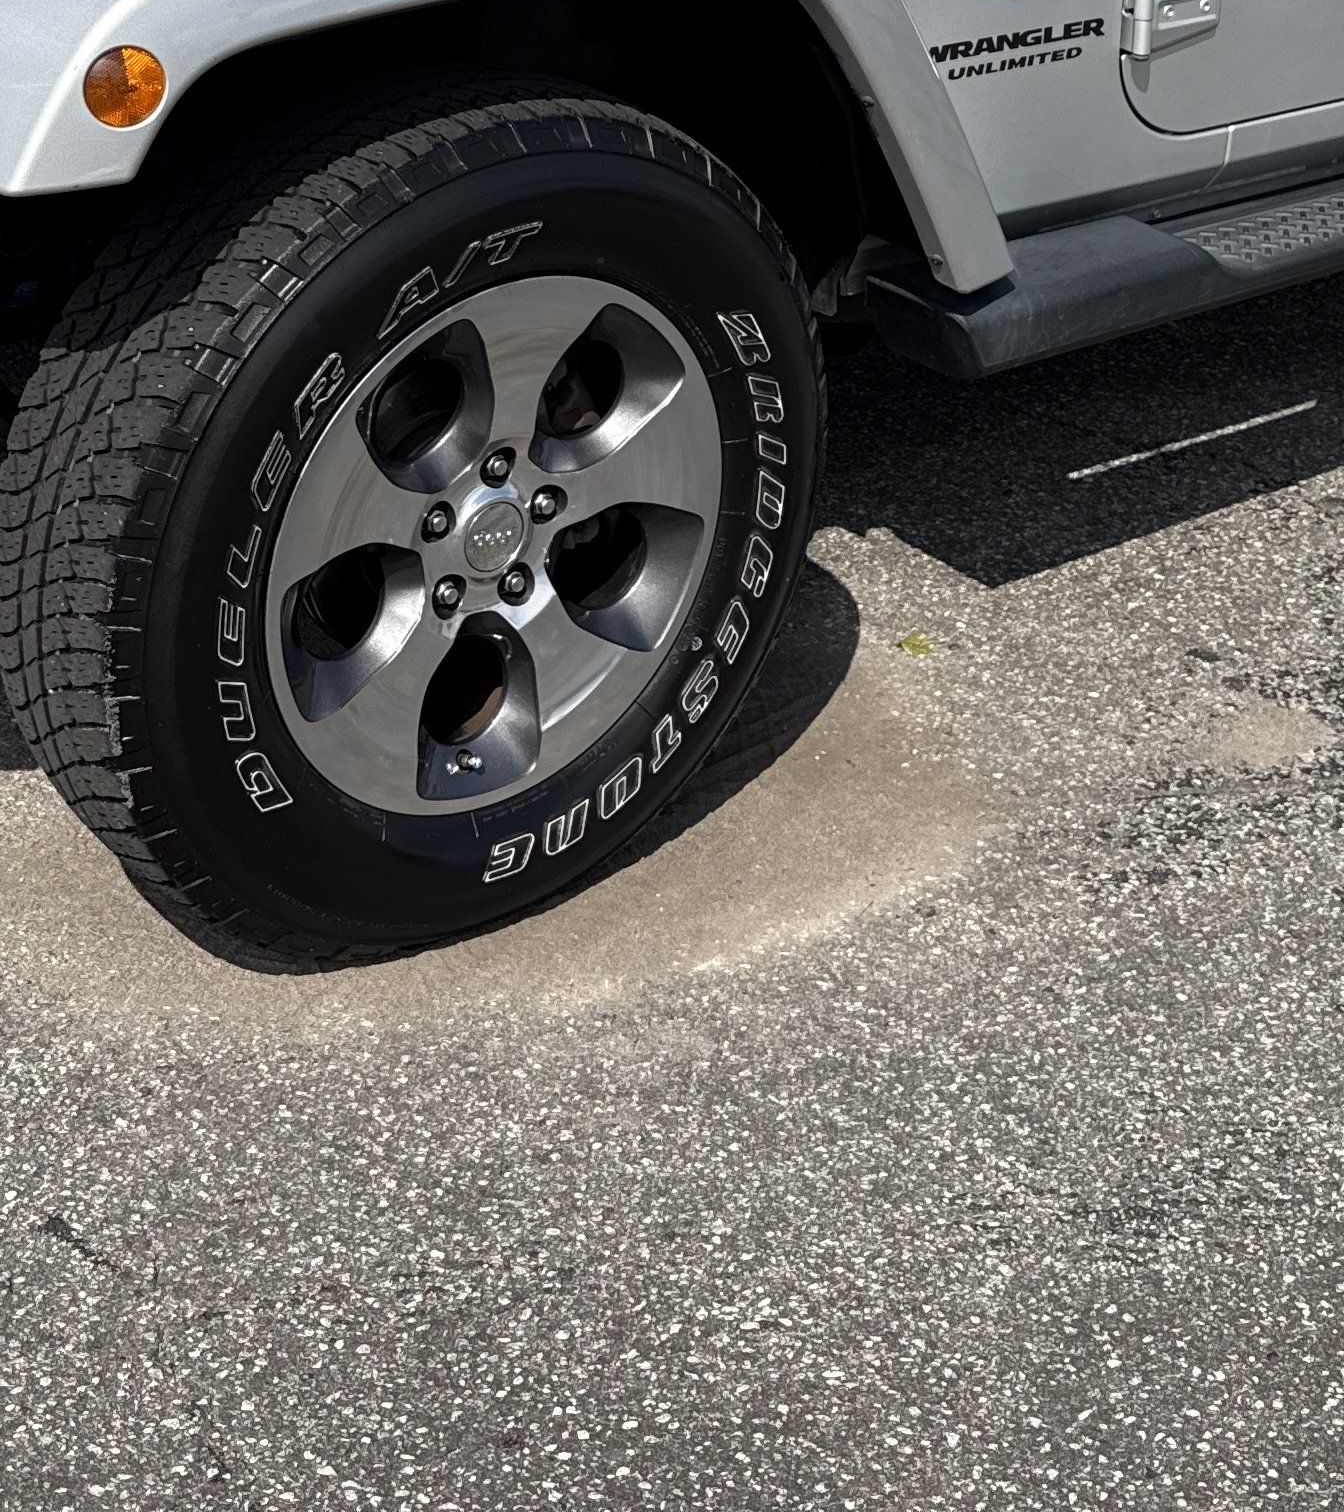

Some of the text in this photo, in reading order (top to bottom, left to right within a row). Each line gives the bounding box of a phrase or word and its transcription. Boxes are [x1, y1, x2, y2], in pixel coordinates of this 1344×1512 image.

[929, 18, 1105, 63] WRANGLER
[948, 46, 1083, 81] UNLIMITED
[217, 220, 544, 813] DUELER A/T
[483, 310, 788, 883] BRIDGESTONE
